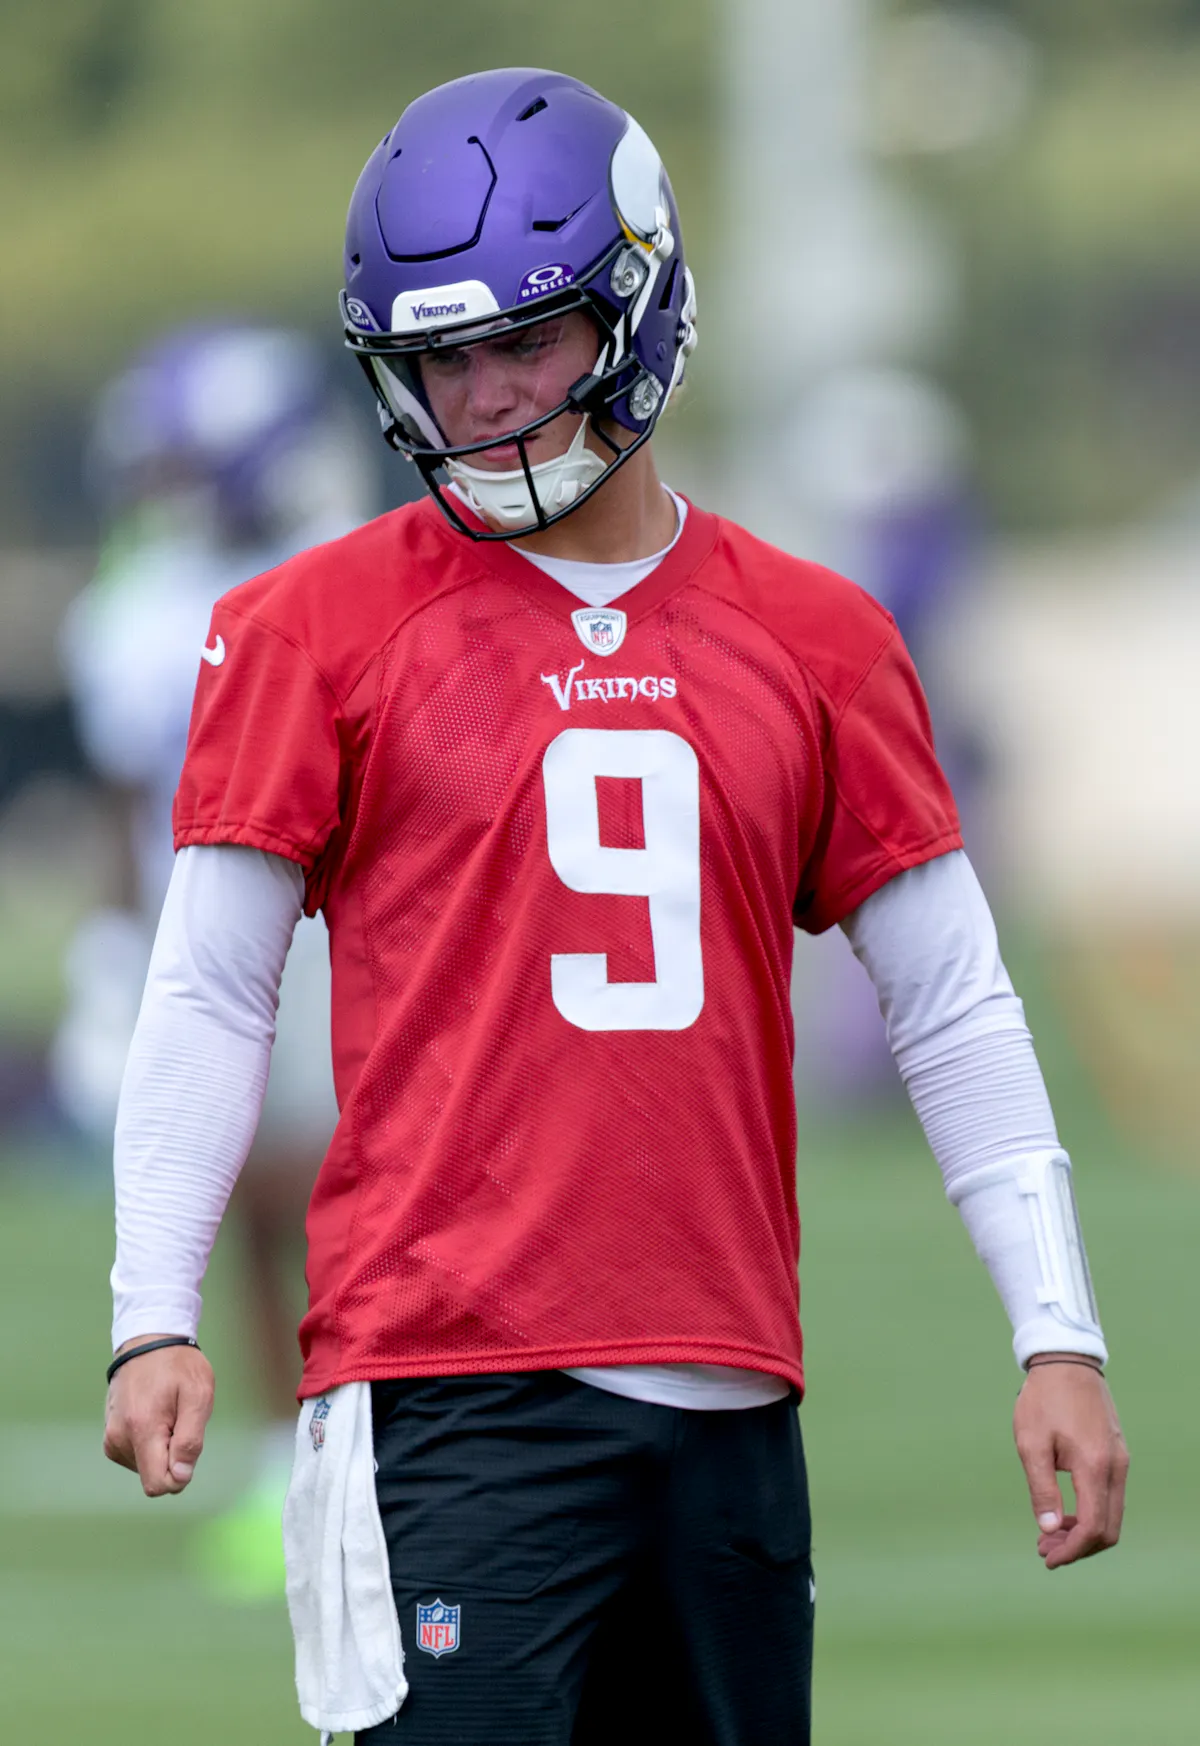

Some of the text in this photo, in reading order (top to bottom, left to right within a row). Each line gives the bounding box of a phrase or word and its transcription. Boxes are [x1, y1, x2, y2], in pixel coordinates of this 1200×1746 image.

[521, 274, 573, 298] OAKLEY
[542, 728, 705, 1031] 9
[421, 1624, 454, 1649] NFL
